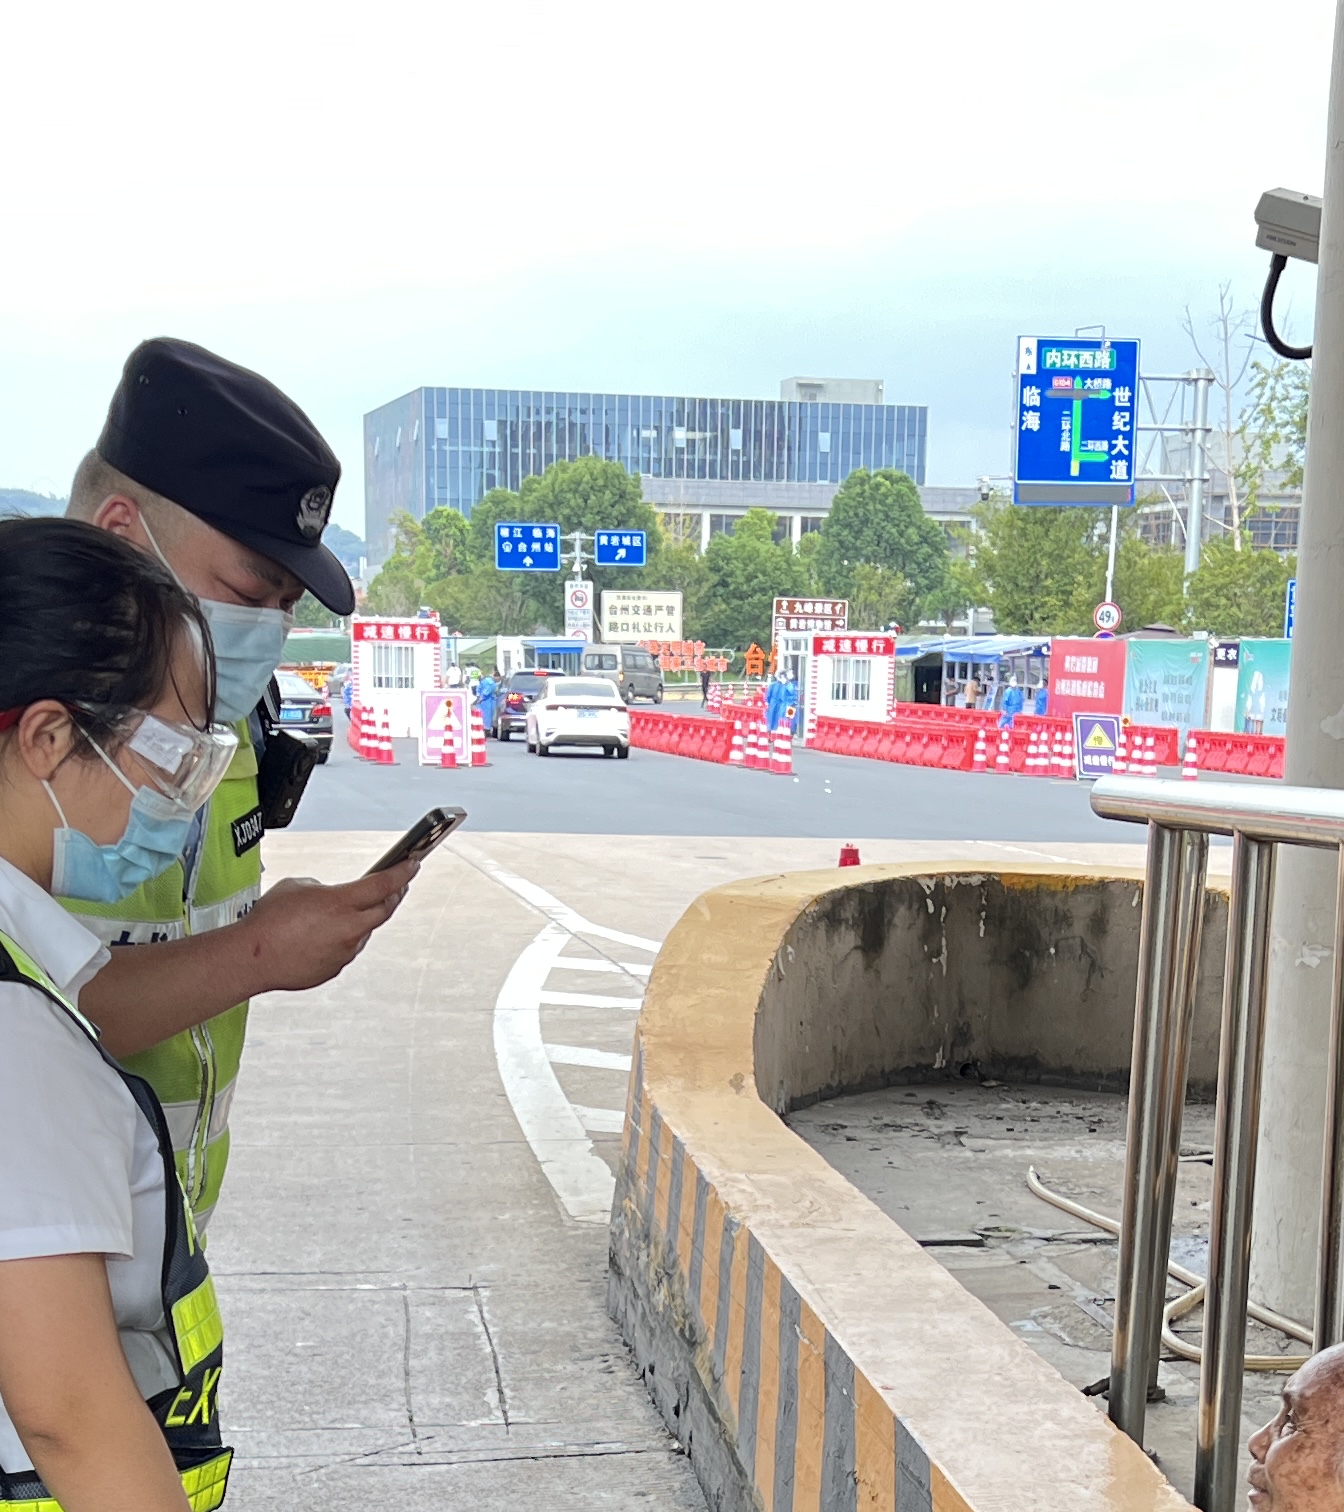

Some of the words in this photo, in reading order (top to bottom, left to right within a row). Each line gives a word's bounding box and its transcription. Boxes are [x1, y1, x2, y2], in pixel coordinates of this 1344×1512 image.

[1045, 349, 1112, 369] 内环西路
[1021, 386, 1041, 431] 临海
[1110, 386, 1132, 480] 世纪大道
[599, 535, 642, 547] 黄岩城区
[608, 604, 676, 616] 台州交通严管
[362, 625, 430, 640] 减速慢行
[608, 622, 676, 633] 路口礼让行人
[822, 639, 886, 653] 减速慢行
